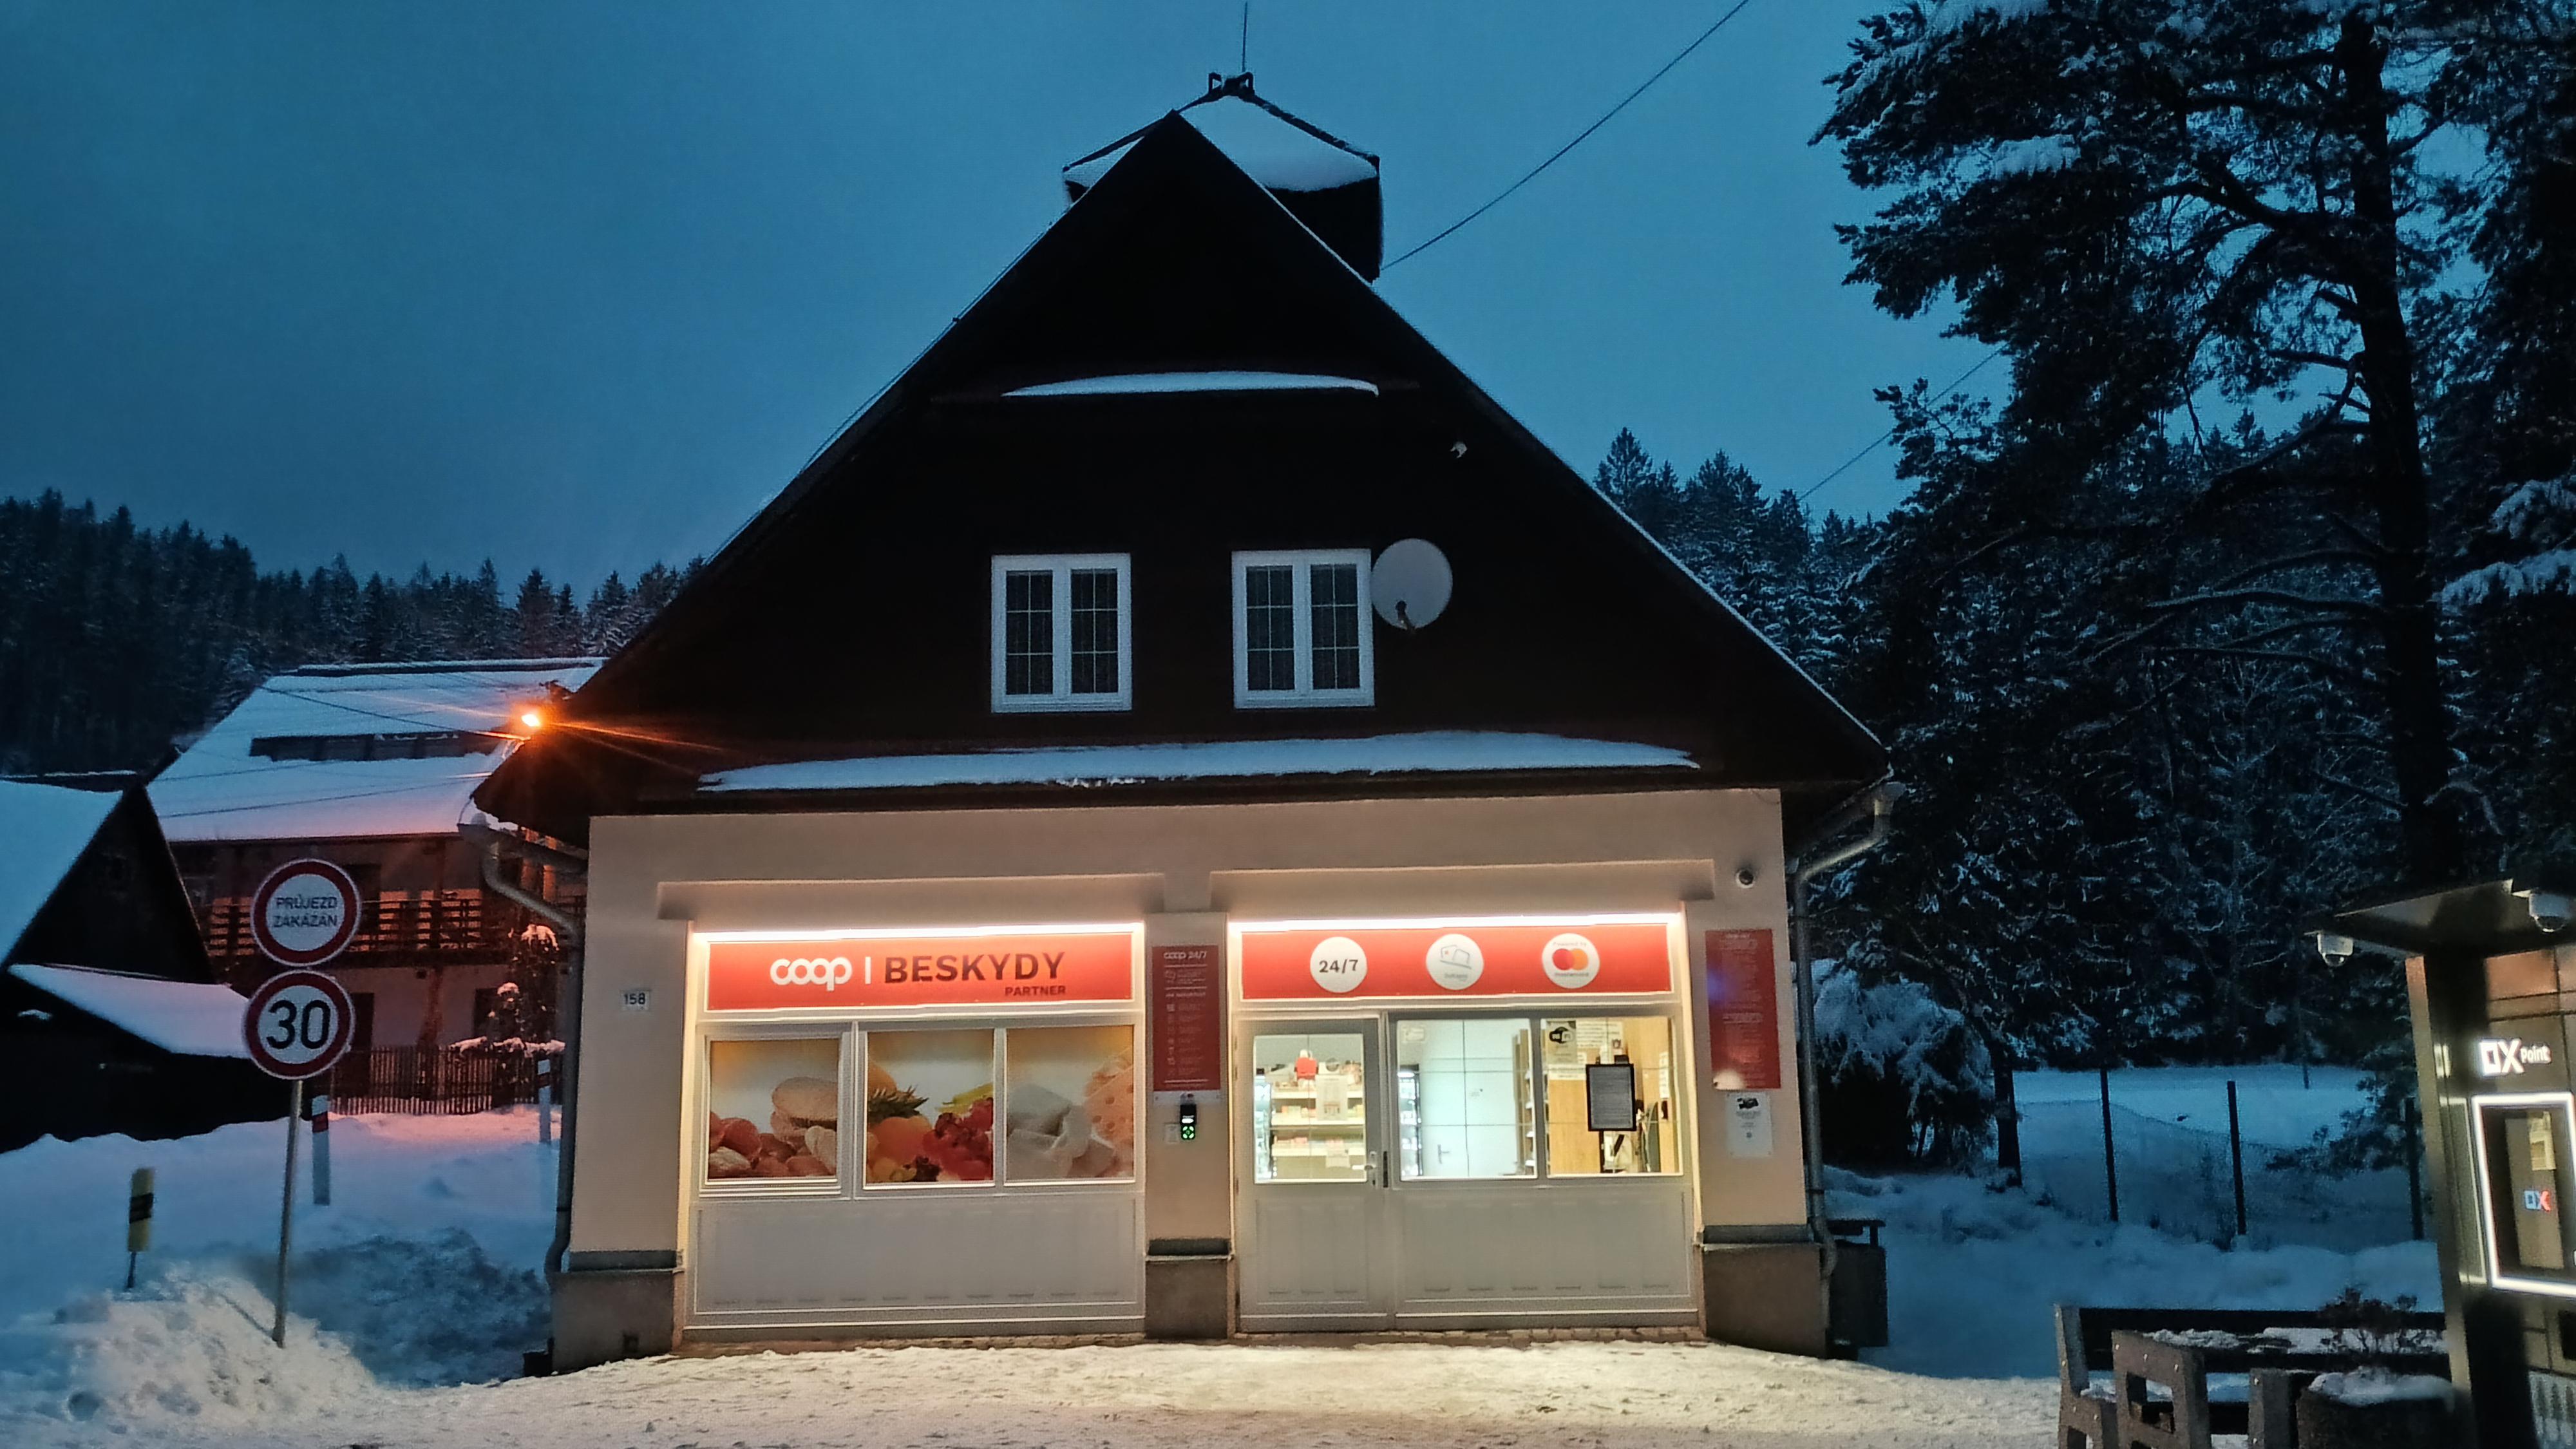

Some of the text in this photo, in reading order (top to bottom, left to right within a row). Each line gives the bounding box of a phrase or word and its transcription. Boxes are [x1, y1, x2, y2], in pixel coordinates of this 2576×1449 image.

[275, 894, 338, 909] PRŮJEZD
[770, 952, 1065, 992] coop BESKYDY
[1319, 959, 1359, 974] 24/7
[1005, 985, 1066, 996] PARTNER
[623, 992, 646, 1005] 158
[266, 999, 331, 1050] 30
[2520, 1045, 2552, 1064] Point
